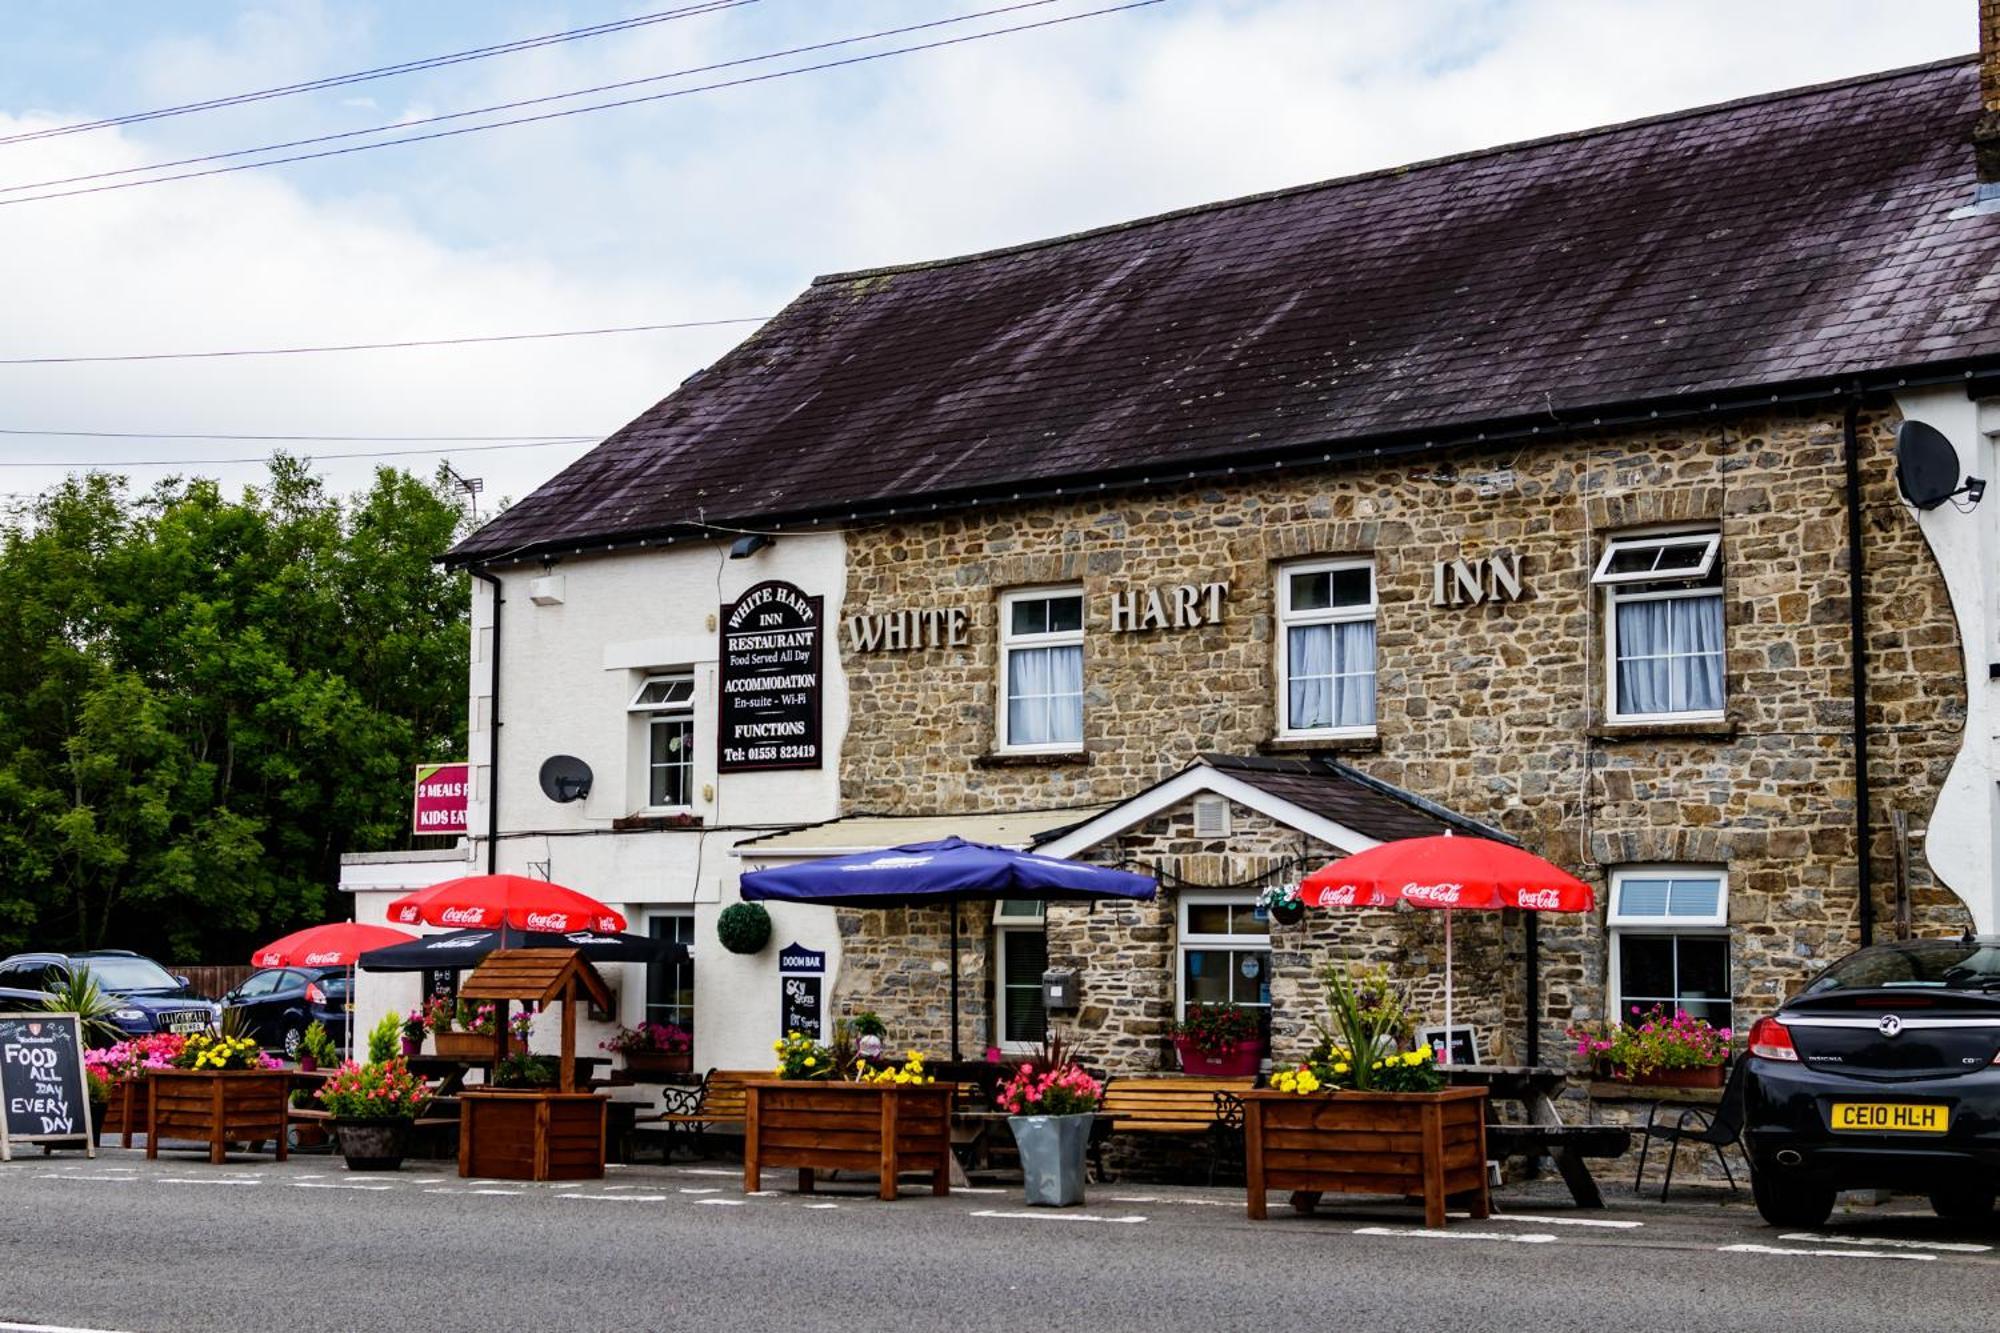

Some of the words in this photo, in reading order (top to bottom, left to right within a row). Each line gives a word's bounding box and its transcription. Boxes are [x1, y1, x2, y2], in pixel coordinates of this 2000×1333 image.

[728, 587, 773, 629] WHITE
[775, 586, 814, 622] HART
[846, 606, 968, 652] WHITE
[1111, 581, 1229, 632] HART
[1433, 554, 1523, 605] INN
[759, 612, 783, 626] INN
[728, 631, 814, 651] RESTAURANT
[729, 653, 750, 666] Food
[751, 651, 778, 664] Served
[780, 649, 793, 662] All
[795, 650, 810, 664] Day
[724, 674, 816, 693] ACCOMMODATION
[733, 696, 773, 709] En-suite
[781, 692, 806, 705] Wi-Fi
[734, 720, 805, 738] FUNCTIONS
[724, 747, 745, 761] Tel:
[748, 746, 777, 760] 01558
[779, 744, 816, 759] 823419
[419, 784, 426, 798] 2
[427, 782, 462, 798] MEALS
[421, 809, 449, 826] KIDS
[783, 956, 805, 967] DOOM
[805, 956, 821, 968] BAR
[4, 1043, 58, 1068] FOOD
[30, 1066, 62, 1081] ALL
[35, 1083, 63, 1100] DAY
[11, 1097, 68, 1118] EVERY
[40, 1115, 73, 1135] DAY
[1894, 1107, 1935, 1127] HLH
